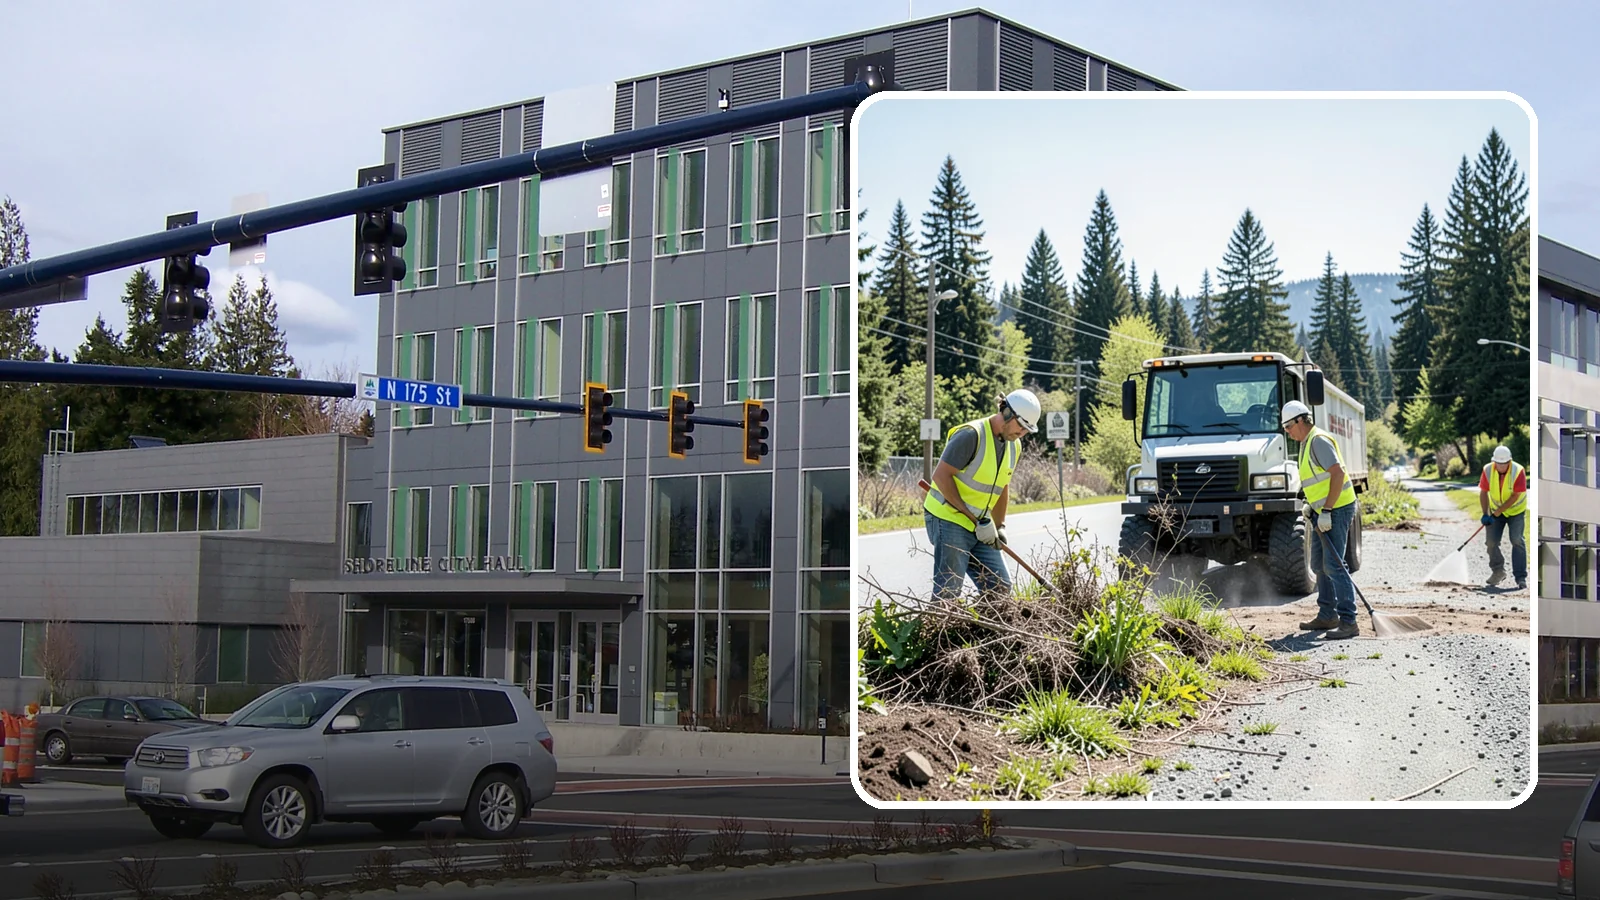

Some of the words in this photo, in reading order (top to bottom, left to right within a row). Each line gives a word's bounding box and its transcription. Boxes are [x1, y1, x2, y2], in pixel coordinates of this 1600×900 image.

[387, 380, 396, 400] N
[405, 382, 427, 403] 175
[436, 386, 451, 406] St
[344, 557, 432, 574] SHORELINE
[438, 556, 476, 572] CITY
[484, 556, 525, 571] HALL
